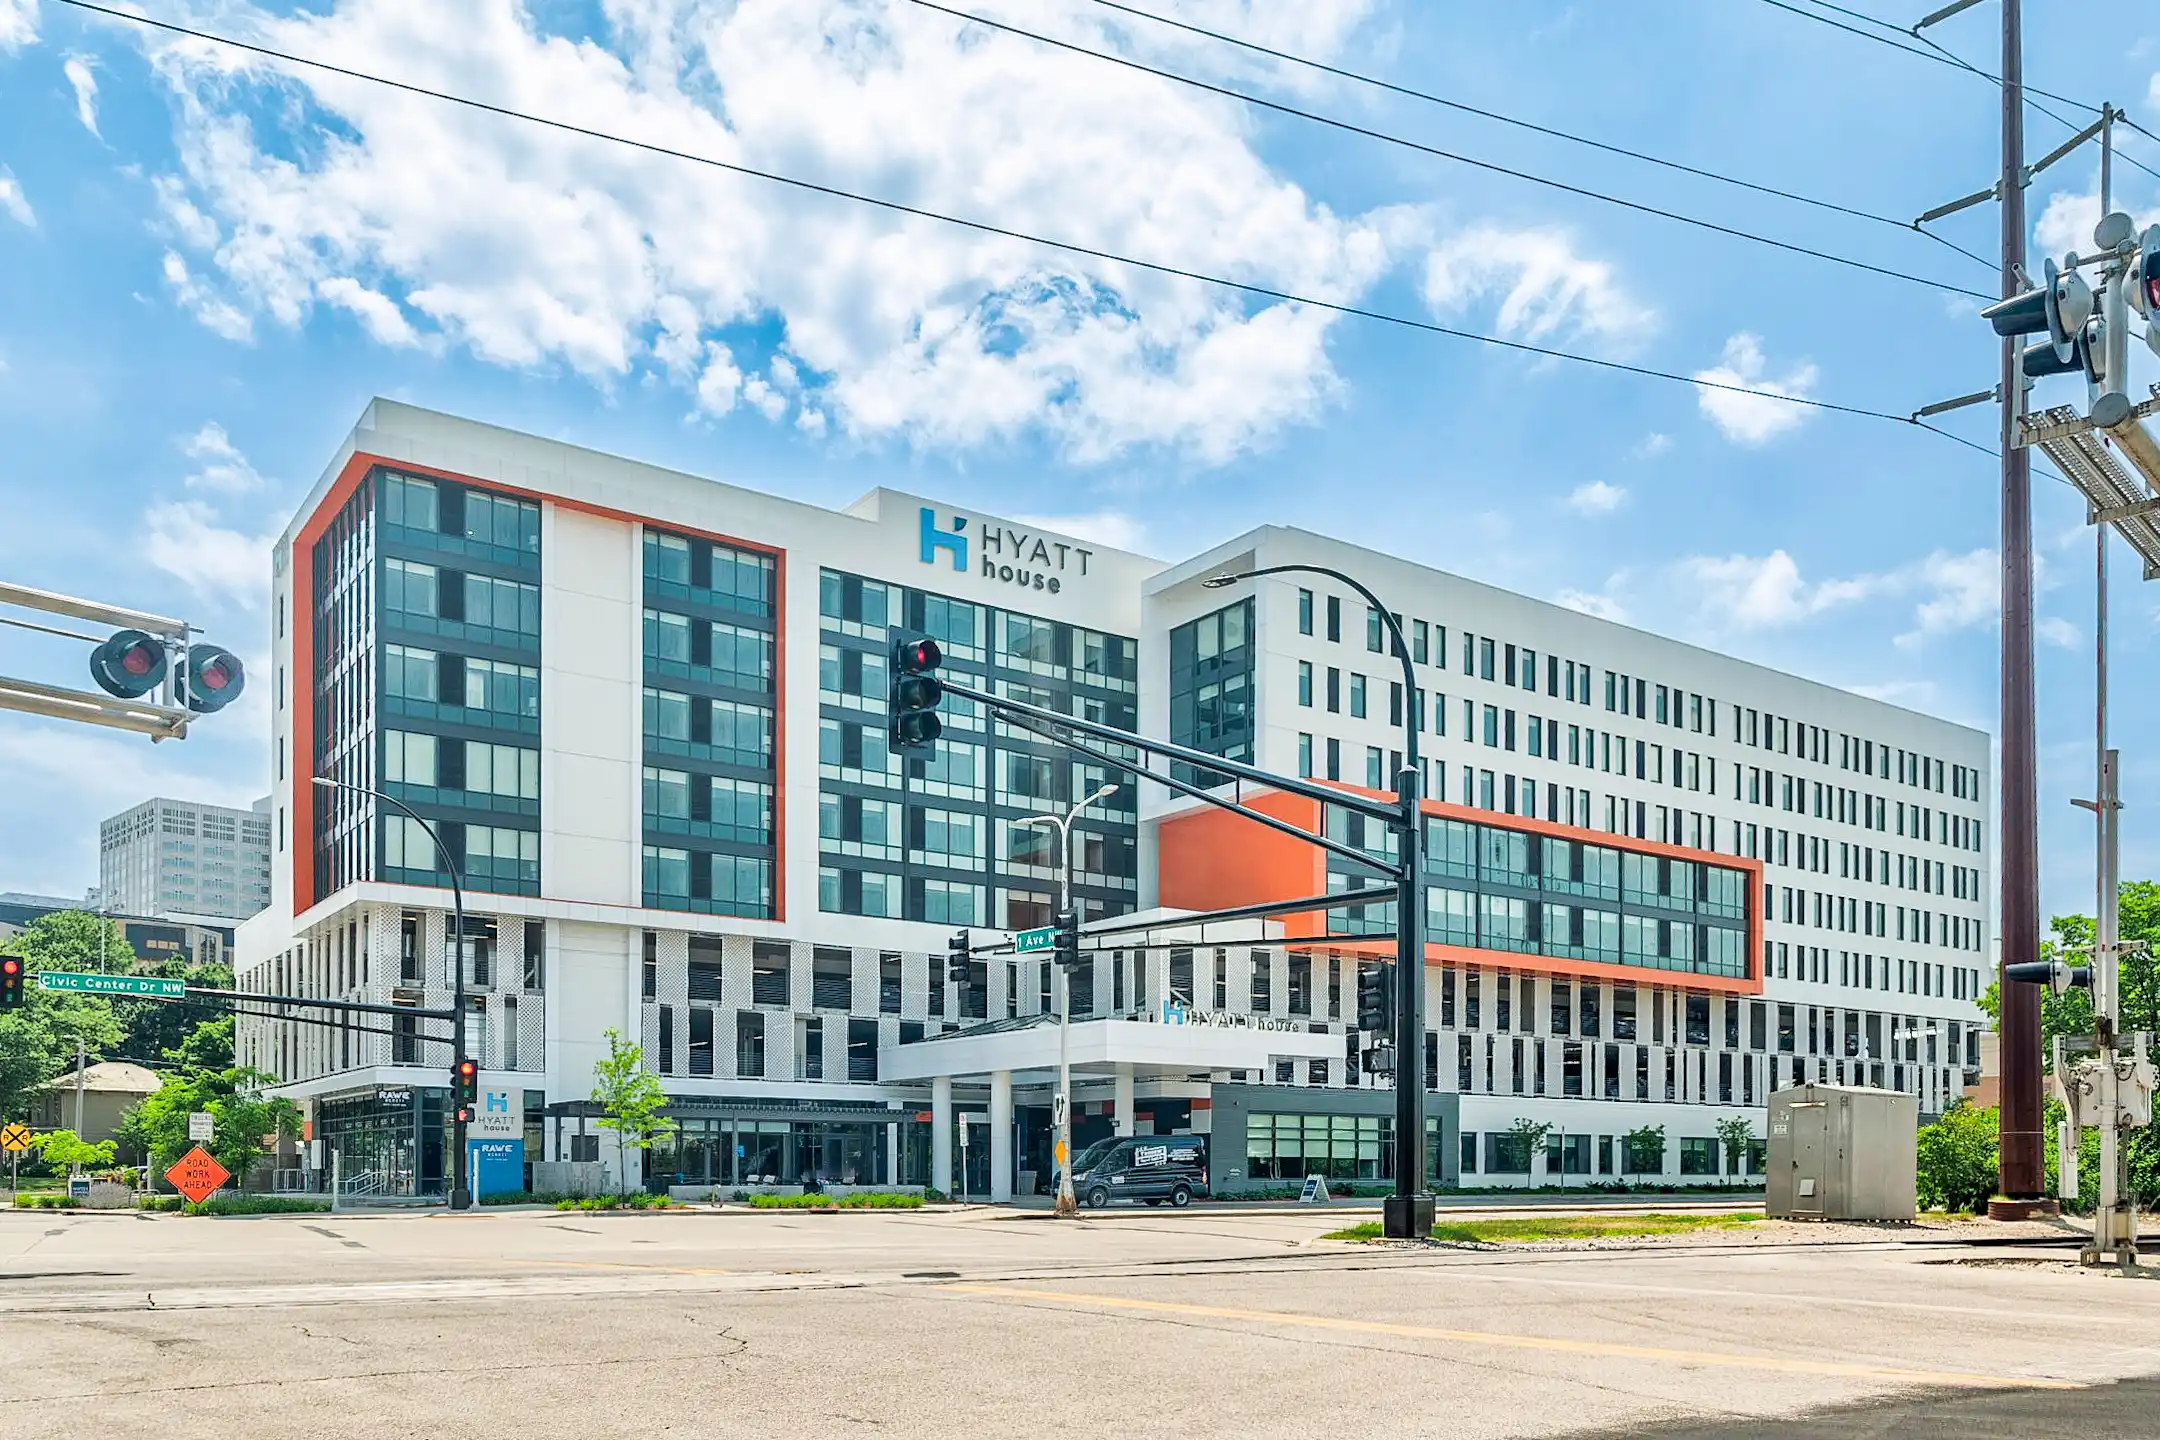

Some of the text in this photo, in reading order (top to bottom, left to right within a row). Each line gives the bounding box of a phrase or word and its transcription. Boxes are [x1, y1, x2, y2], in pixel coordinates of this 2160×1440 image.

[982, 523, 1093, 576] HYATT
[982, 554, 1061, 594] house
[1018, 937, 1022, 948] 1
[1026, 935, 1044, 946] Ave
[41, 975, 182, 993] Civic Center Dr NW
[1187, 1010, 1300, 1033] HYATT house
[478, 1116, 516, 1125] HYATT
[186, 1158, 209, 1168] ROAD
[186, 1169, 210, 1178] WORK
[184, 1180, 212, 1189] AHEAD
